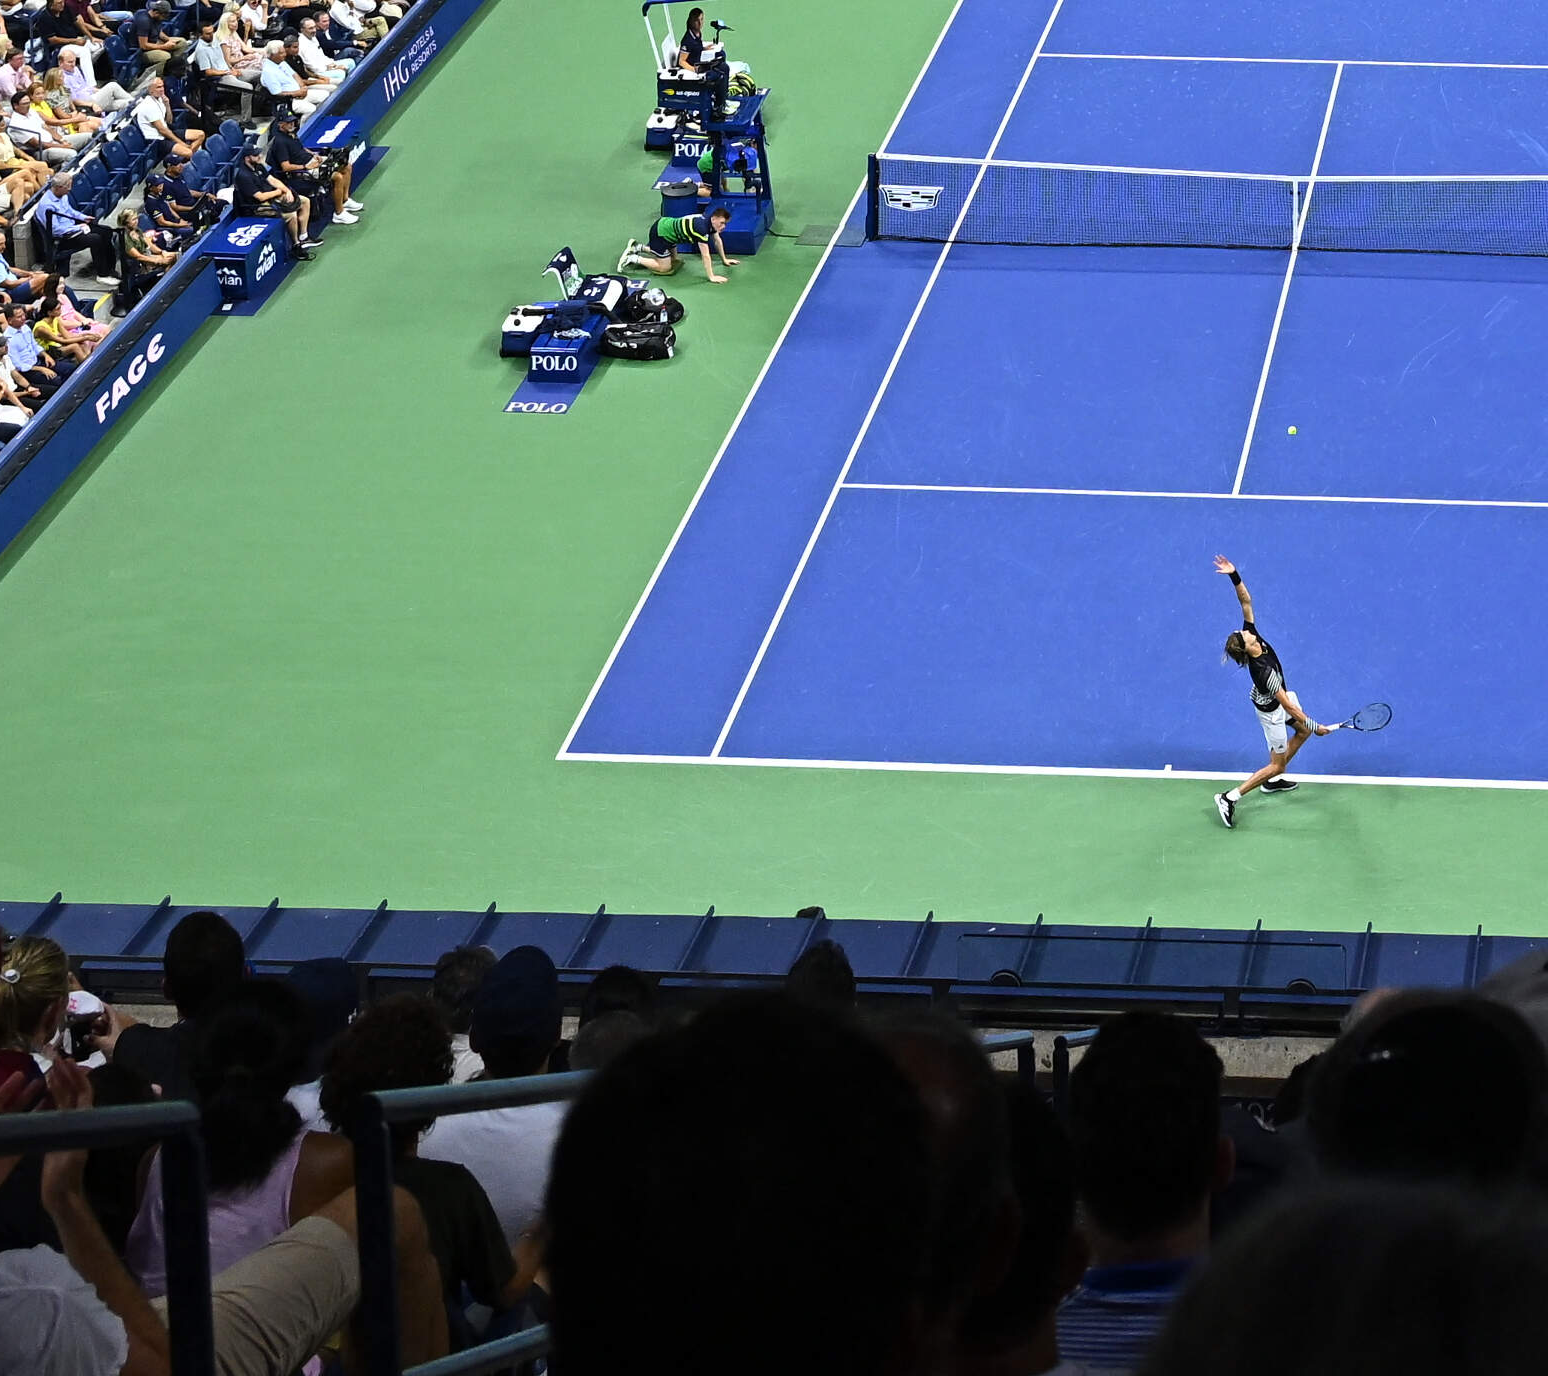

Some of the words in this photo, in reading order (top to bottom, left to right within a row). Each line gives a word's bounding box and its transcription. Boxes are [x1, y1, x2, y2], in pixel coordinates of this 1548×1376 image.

[408, 31, 428, 60] HOTELS
[409, 40, 437, 74] RESORTS
[382, 54, 411, 104] IHG
[217, 273, 243, 286] vian
[255, 252, 277, 282] evian
[531, 355, 578, 372] POLO
[505, 401, 568, 415] POLO
